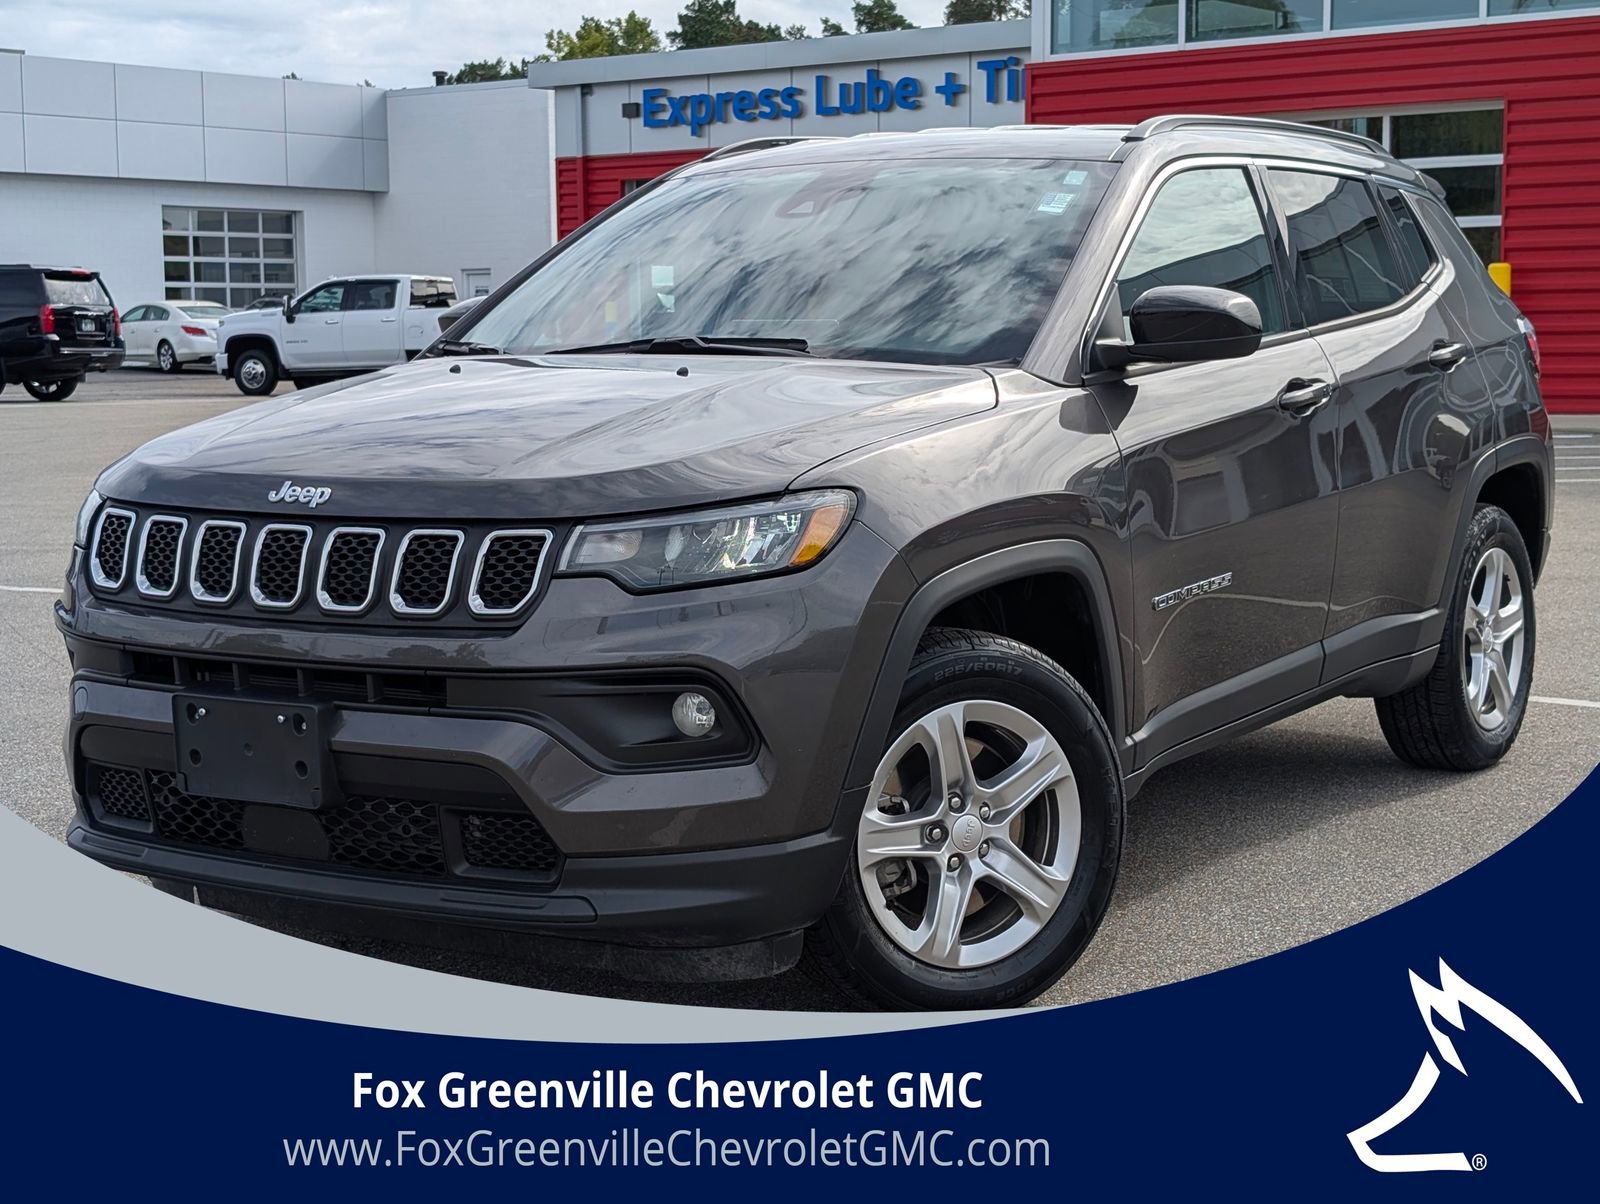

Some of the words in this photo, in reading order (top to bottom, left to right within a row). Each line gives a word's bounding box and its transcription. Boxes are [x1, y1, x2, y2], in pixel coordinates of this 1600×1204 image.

[643, 87, 803, 137] Express
[815, 68, 921, 117] Lube
[976, 55, 1026, 105] Ti
[267, 480, 332, 508] Jeep
[1151, 571, 1233, 612] COMPASS
[933, 660, 1024, 682] 225/60R17
